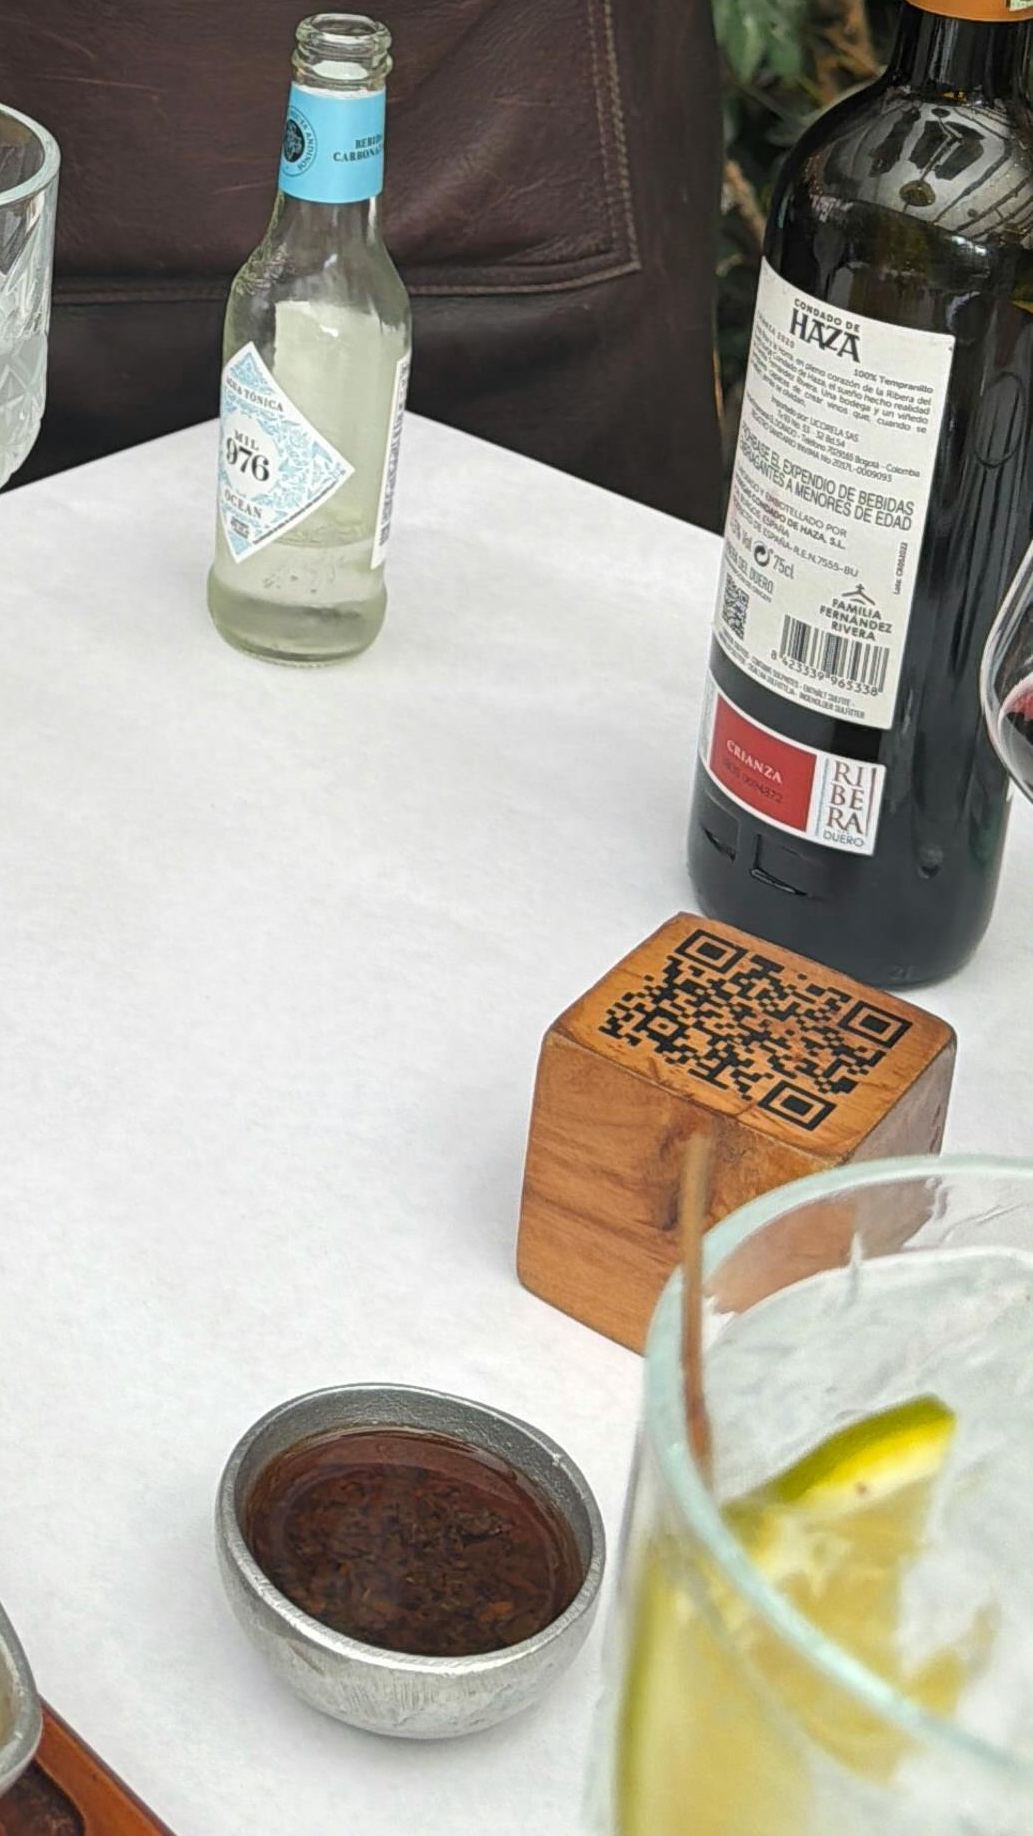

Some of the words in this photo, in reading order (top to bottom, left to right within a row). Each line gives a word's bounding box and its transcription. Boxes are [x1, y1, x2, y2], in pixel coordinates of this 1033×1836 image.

[794, 298, 842, 326] CONDADO
[844, 316, 861, 333] DE
[789, 307, 861, 364] HAZA
[916, 396, 932, 406] del
[234, 429, 260, 451] MIL
[226, 437, 270, 482] 976
[782, 458, 837, 495] EXPENDIO
[837, 483, 857, 503] DE
[857, 490, 915, 516] BEBIDAS
[224, 488, 263, 519] OCEAN
[784, 477, 794, 494] A
[794, 481, 852, 517] MENORES
[853, 504, 873, 524] DE
[874, 510, 913, 532] EDAD
[786, 517, 799, 531] DE
[825, 523, 848, 538] POR
[772, 554, 795, 580] 75cl
[818, 604, 893, 634] FERNÁNDEZ
[831, 598, 882, 621] FAMILIA
[830, 620, 877, 642] RIVERA
[726, 739, 783, 785] CRIANZA
[823, 830, 865, 848] DUERO
